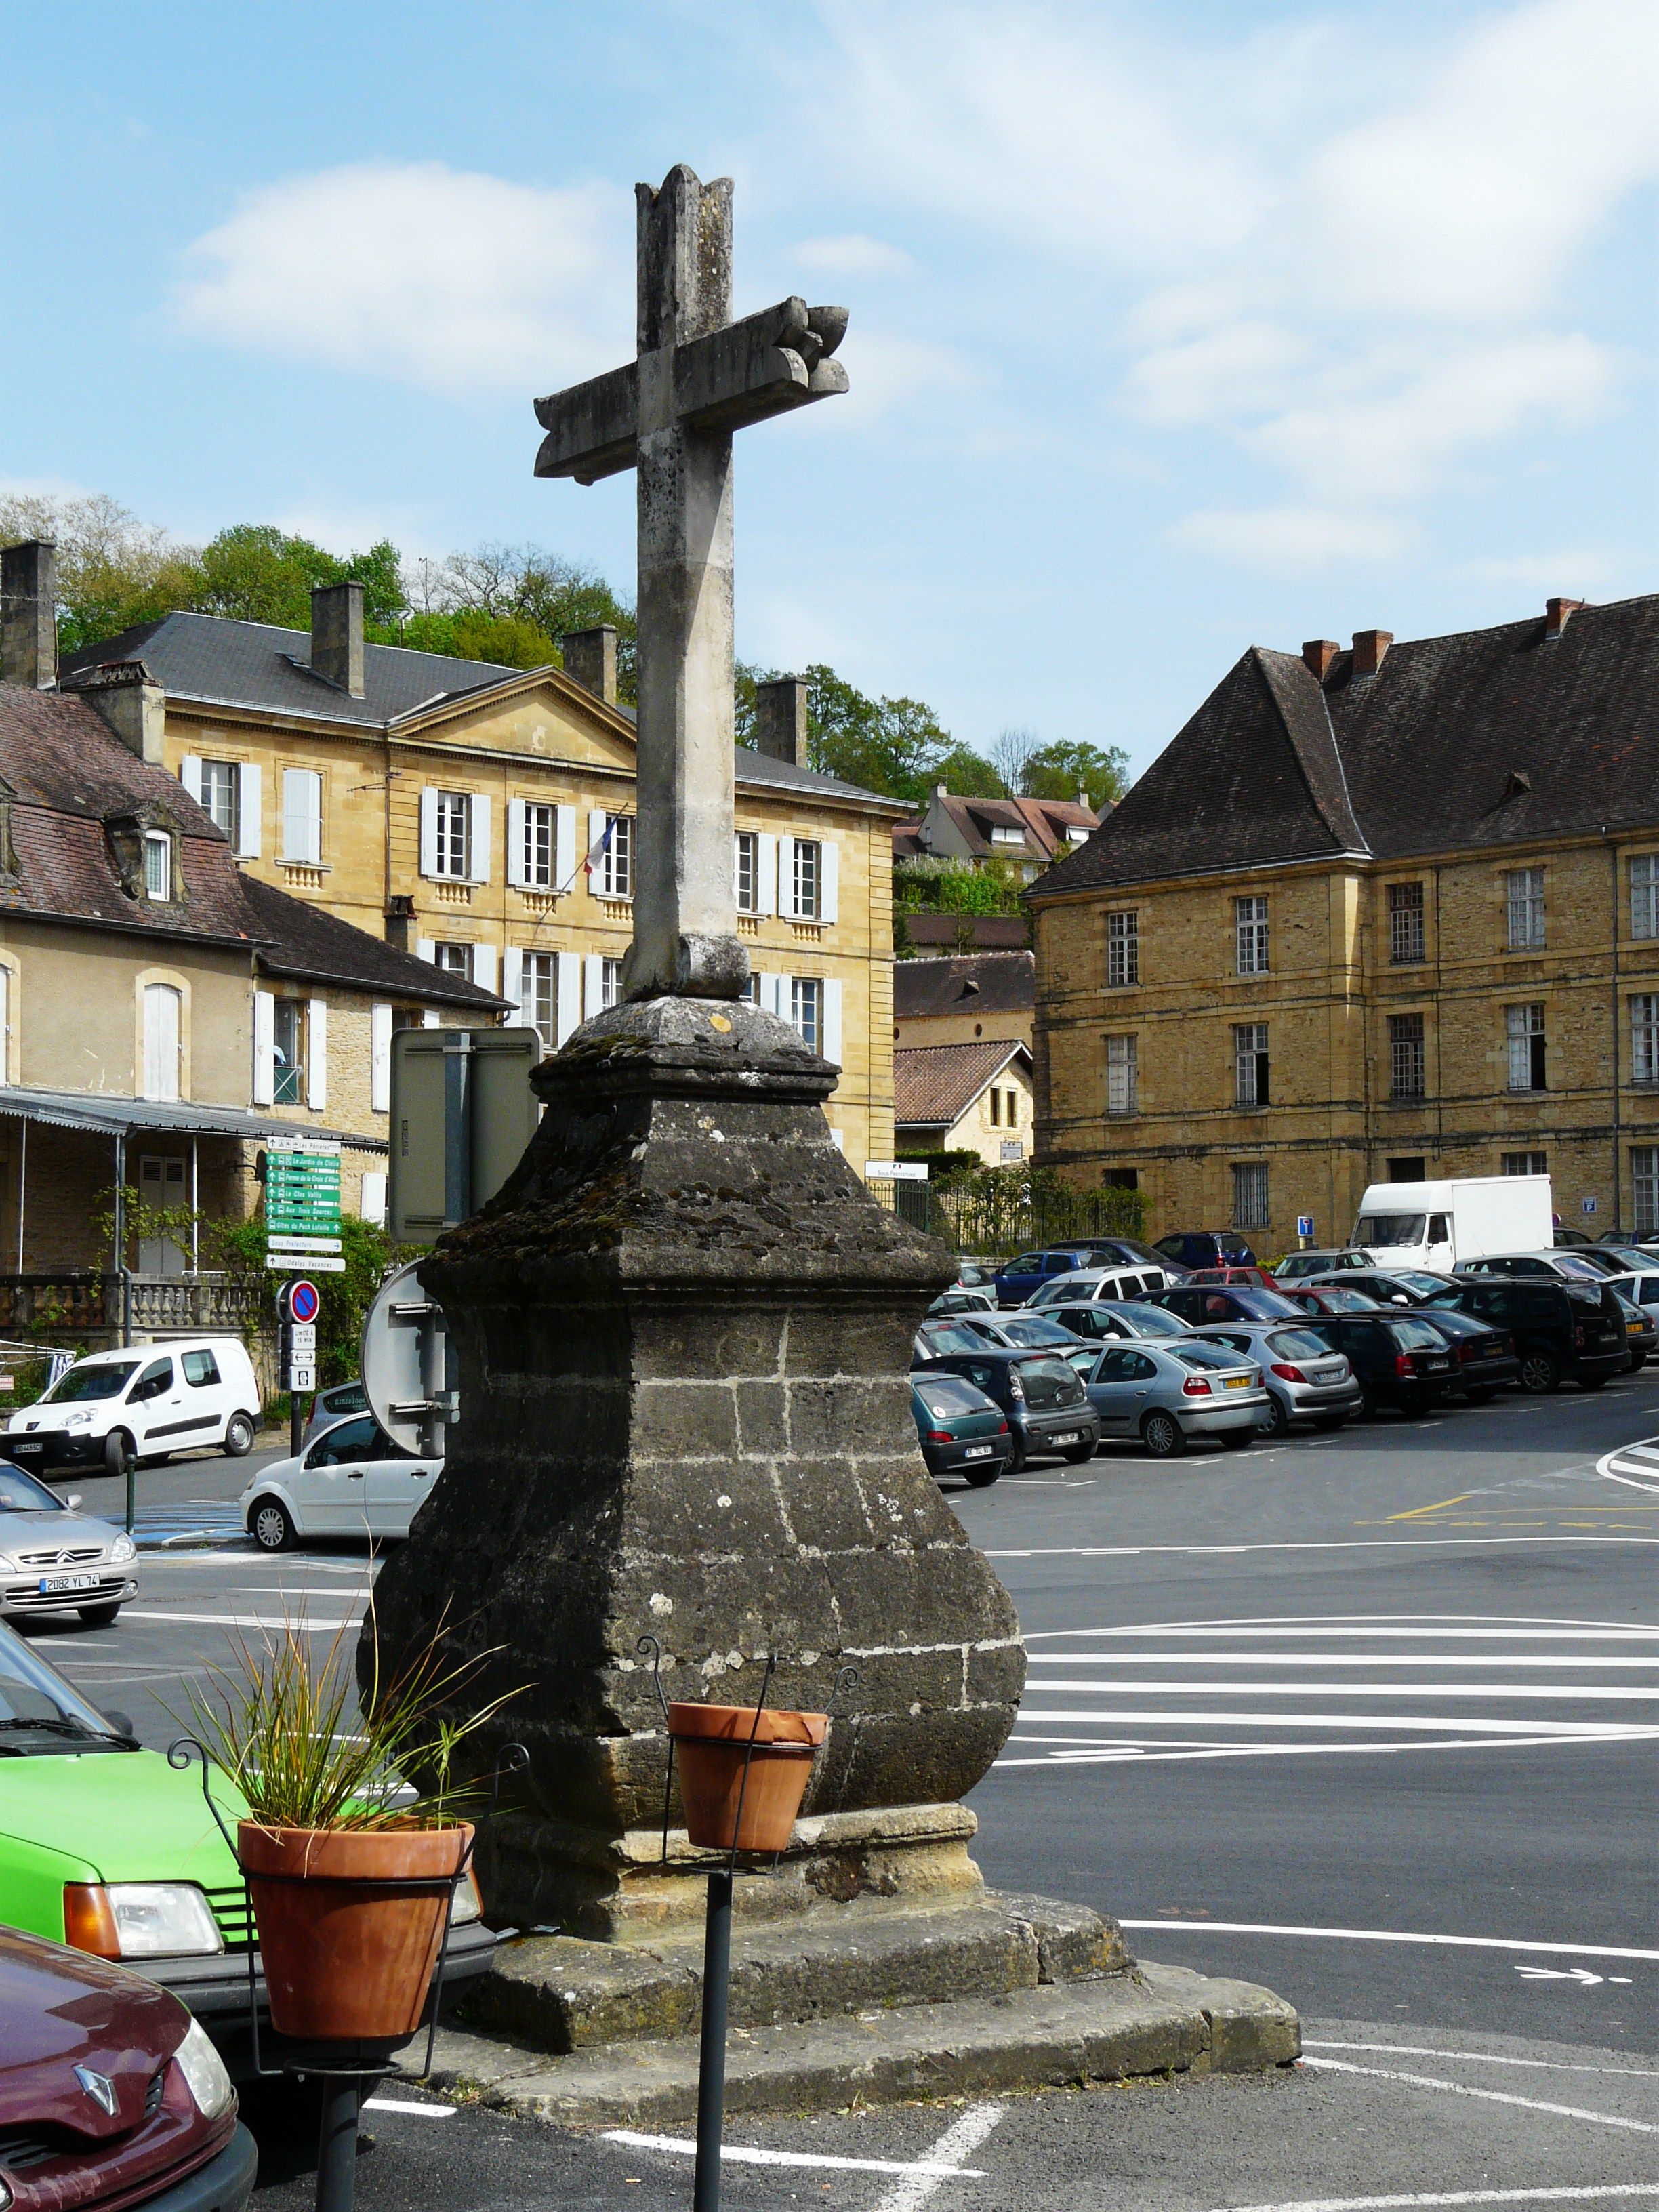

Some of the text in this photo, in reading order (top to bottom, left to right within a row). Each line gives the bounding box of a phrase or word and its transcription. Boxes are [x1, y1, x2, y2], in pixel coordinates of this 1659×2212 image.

[312, 1208, 333, 1216] Sources
[287, 1259, 305, 1267] Odalys
[47, 1576, 97, 1591] 2082 YL 74
